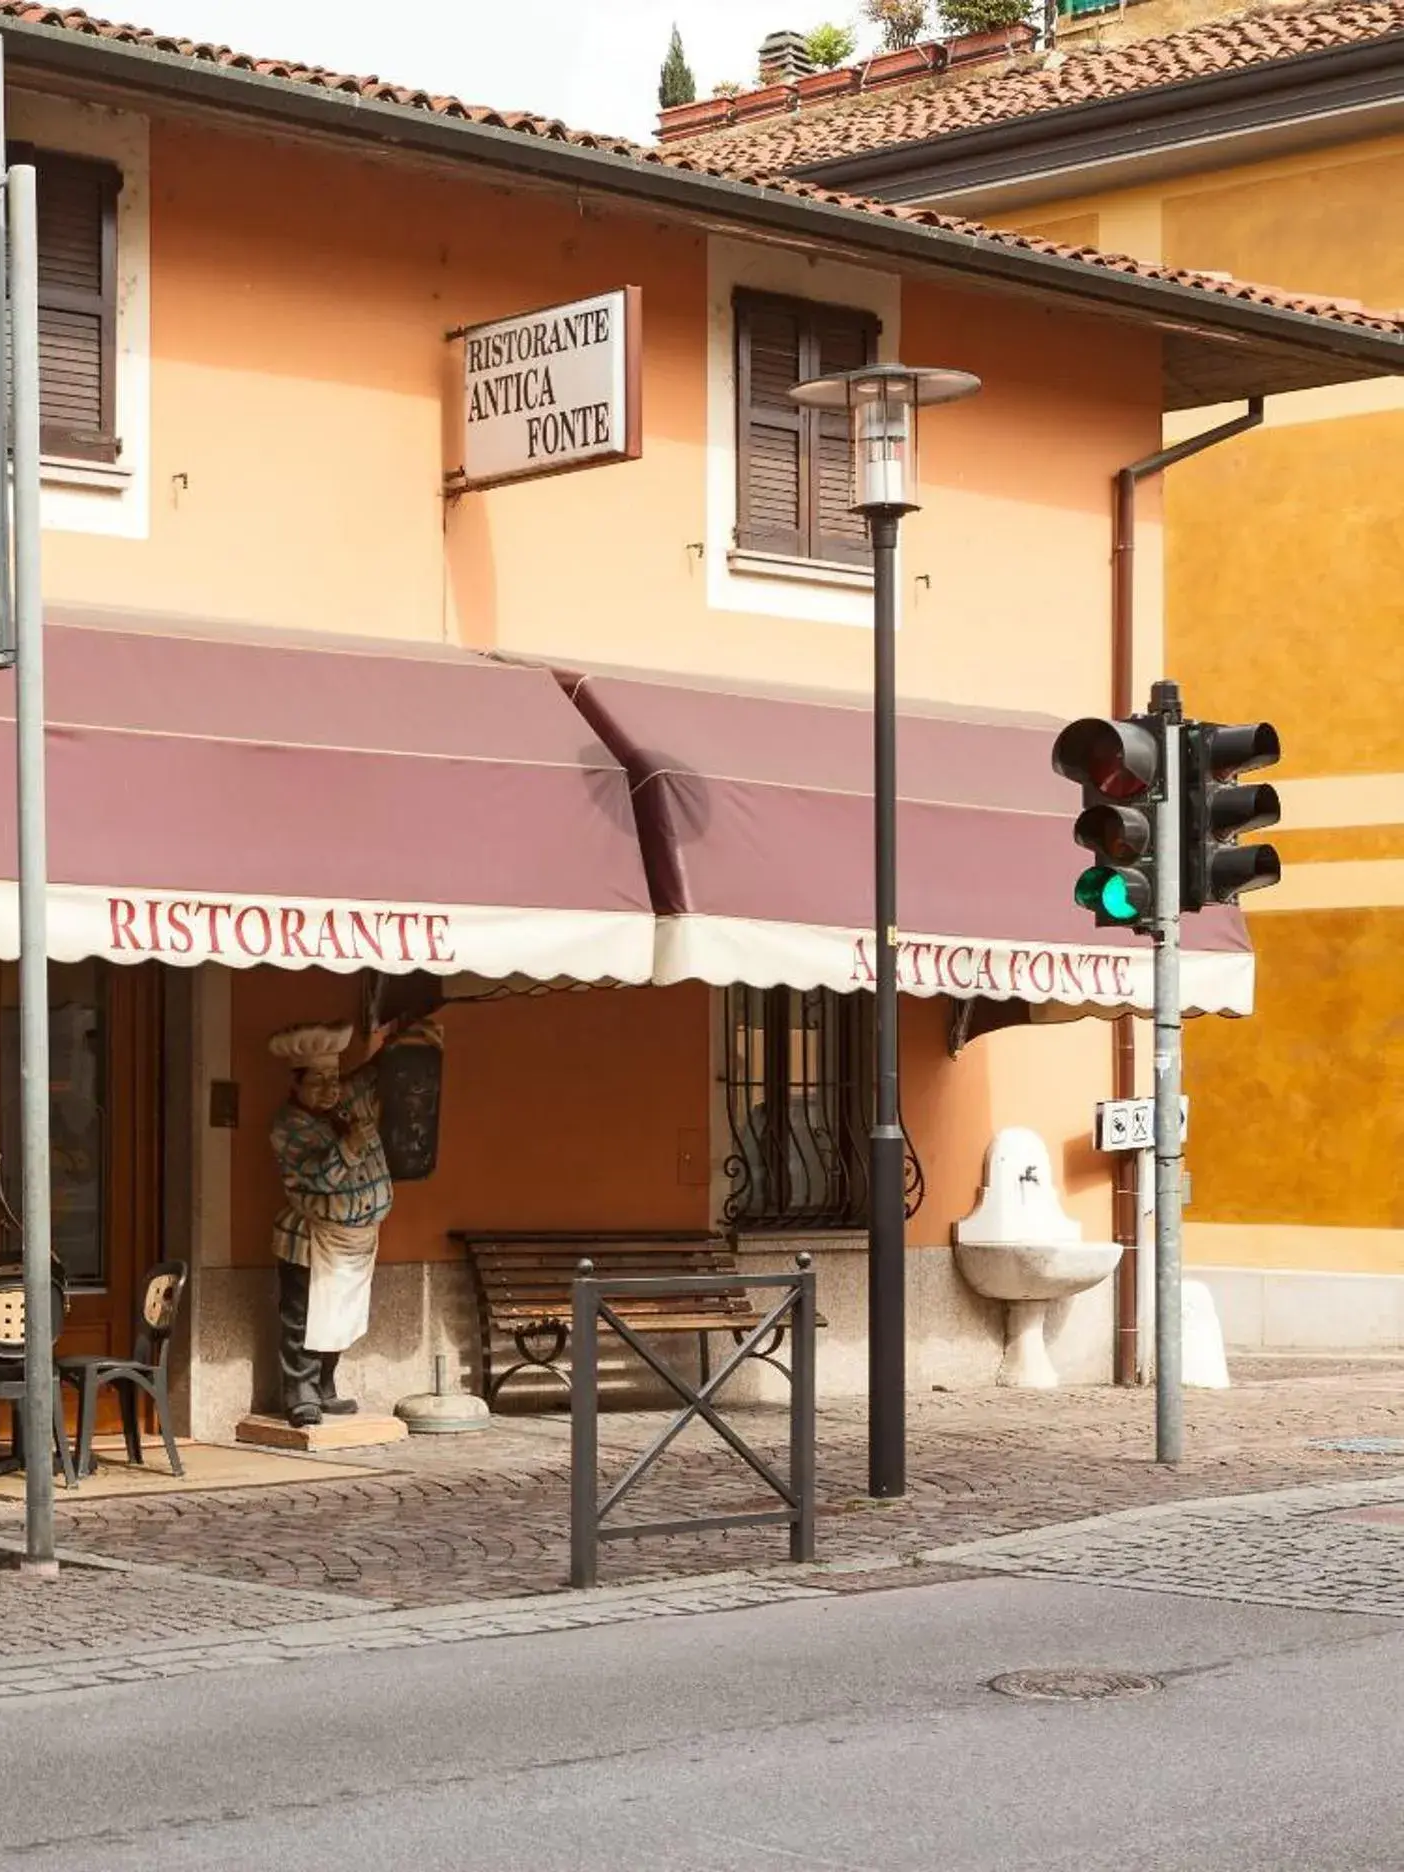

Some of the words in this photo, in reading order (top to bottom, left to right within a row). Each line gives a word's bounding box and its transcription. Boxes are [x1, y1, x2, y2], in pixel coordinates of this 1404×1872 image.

[468, 308, 609, 374] RISTORANTE
[468, 365, 556, 423] ANTICA
[527, 402, 609, 459] FONTE
[107, 897, 456, 963] RISTORANTE
[849, 936, 999, 991] ATICA
[1009, 949, 1136, 997] FONTE
